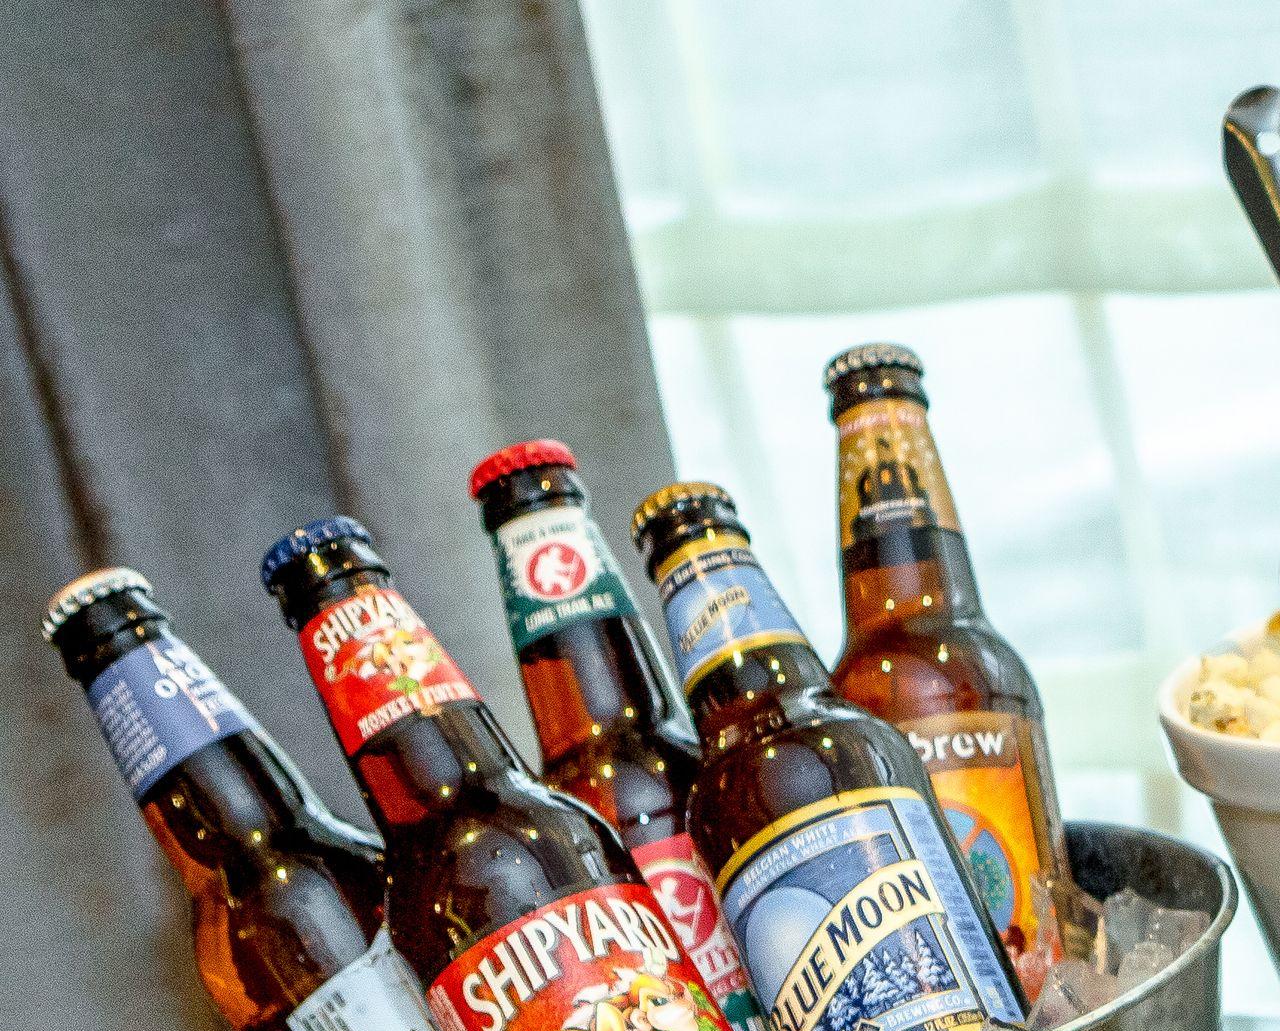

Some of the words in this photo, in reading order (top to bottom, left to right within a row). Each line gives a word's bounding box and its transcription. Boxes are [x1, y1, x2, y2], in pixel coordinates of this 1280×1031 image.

[707, 585, 747, 615] MOON
[743, 845, 790, 884] BELGIAN
[791, 822, 837, 849] WHITE
[826, 867, 932, 966] MOON
[886, 1000, 940, 1030] BREWING
